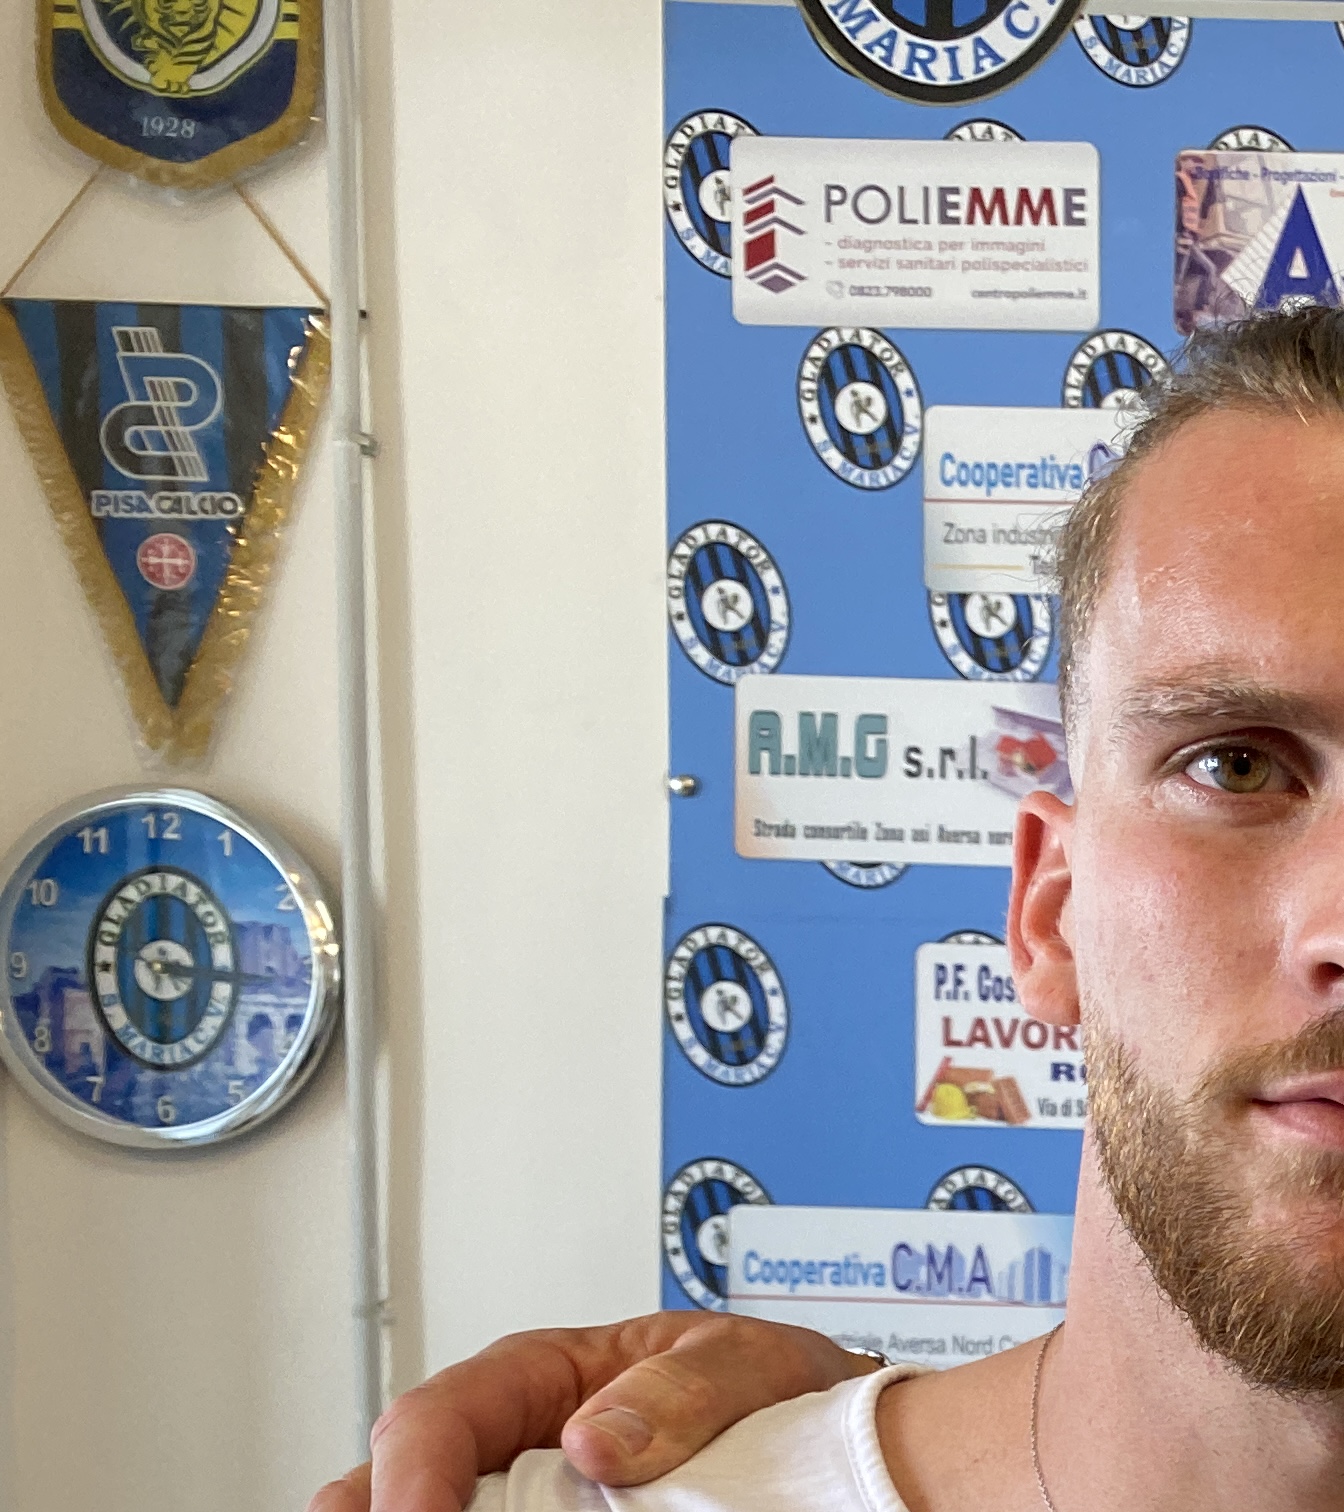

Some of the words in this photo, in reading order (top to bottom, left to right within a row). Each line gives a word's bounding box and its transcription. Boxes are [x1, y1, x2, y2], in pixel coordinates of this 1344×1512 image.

[829, 1, 1006, 82] MARIA
[139, 116, 196, 139] 1928
[824, 183, 1088, 226] POLIEMME
[940, 452, 1082, 496] Cooperativa
[942, 521, 987, 544] Zona
[78, 826, 110, 854] 11
[142, 813, 182, 840] 12
[218, 830, 234, 856] 1
[27, 878, 59, 907] 10
[10, 951, 29, 978] 9
[935, 963, 972, 1000] P.F.
[228, 1078, 245, 1103] 5
[157, 1097, 177, 1123] 6
[742, 1250, 887, 1292] Cooperativa
